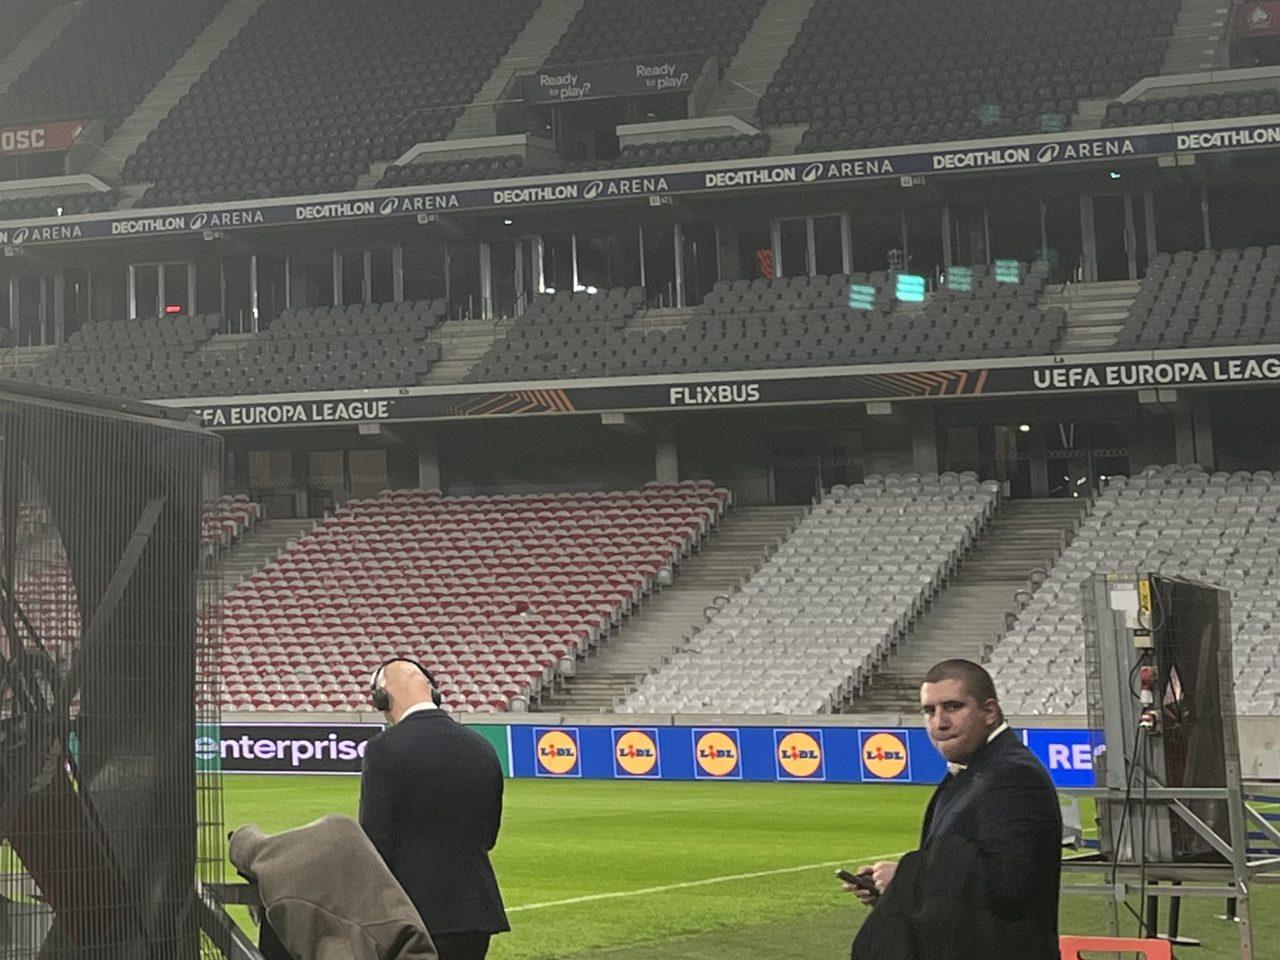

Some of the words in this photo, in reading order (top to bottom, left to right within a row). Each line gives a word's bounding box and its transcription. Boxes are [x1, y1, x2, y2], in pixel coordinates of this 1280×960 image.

[540, 72, 578, 86] Ready
[636, 63, 676, 77] Ready
[646, 79, 656, 87] to
[657, 73, 689, 90] play?
[549, 89, 559, 97] to
[560, 83, 591, 100] play?
[1177, 127, 1280, 150] DECATHLON
[933, 148, 1030, 169] DECATHLON
[1064, 140, 1135, 159] ARENA
[705, 167, 796, 187] DECATHLON
[827, 160, 894, 178] ARENA
[494, 185, 577, 203] DECATHLON
[608, 178, 668, 194] ARENA
[296, 201, 374, 219] DECATHLON
[402, 195, 459, 211] ARENA
[31, 225, 82, 240] ARENA
[112, 217, 185, 234] DECATHLON
[210, 210, 264, 226] ARENA
[1033, 367, 1100, 389] UEFA
[1105, 362, 1208, 385] EUROPA
[1213, 358, 1280, 380] LEAG
[231, 404, 307, 424] EUROPA
[312, 400, 389, 421] LEAGUE
